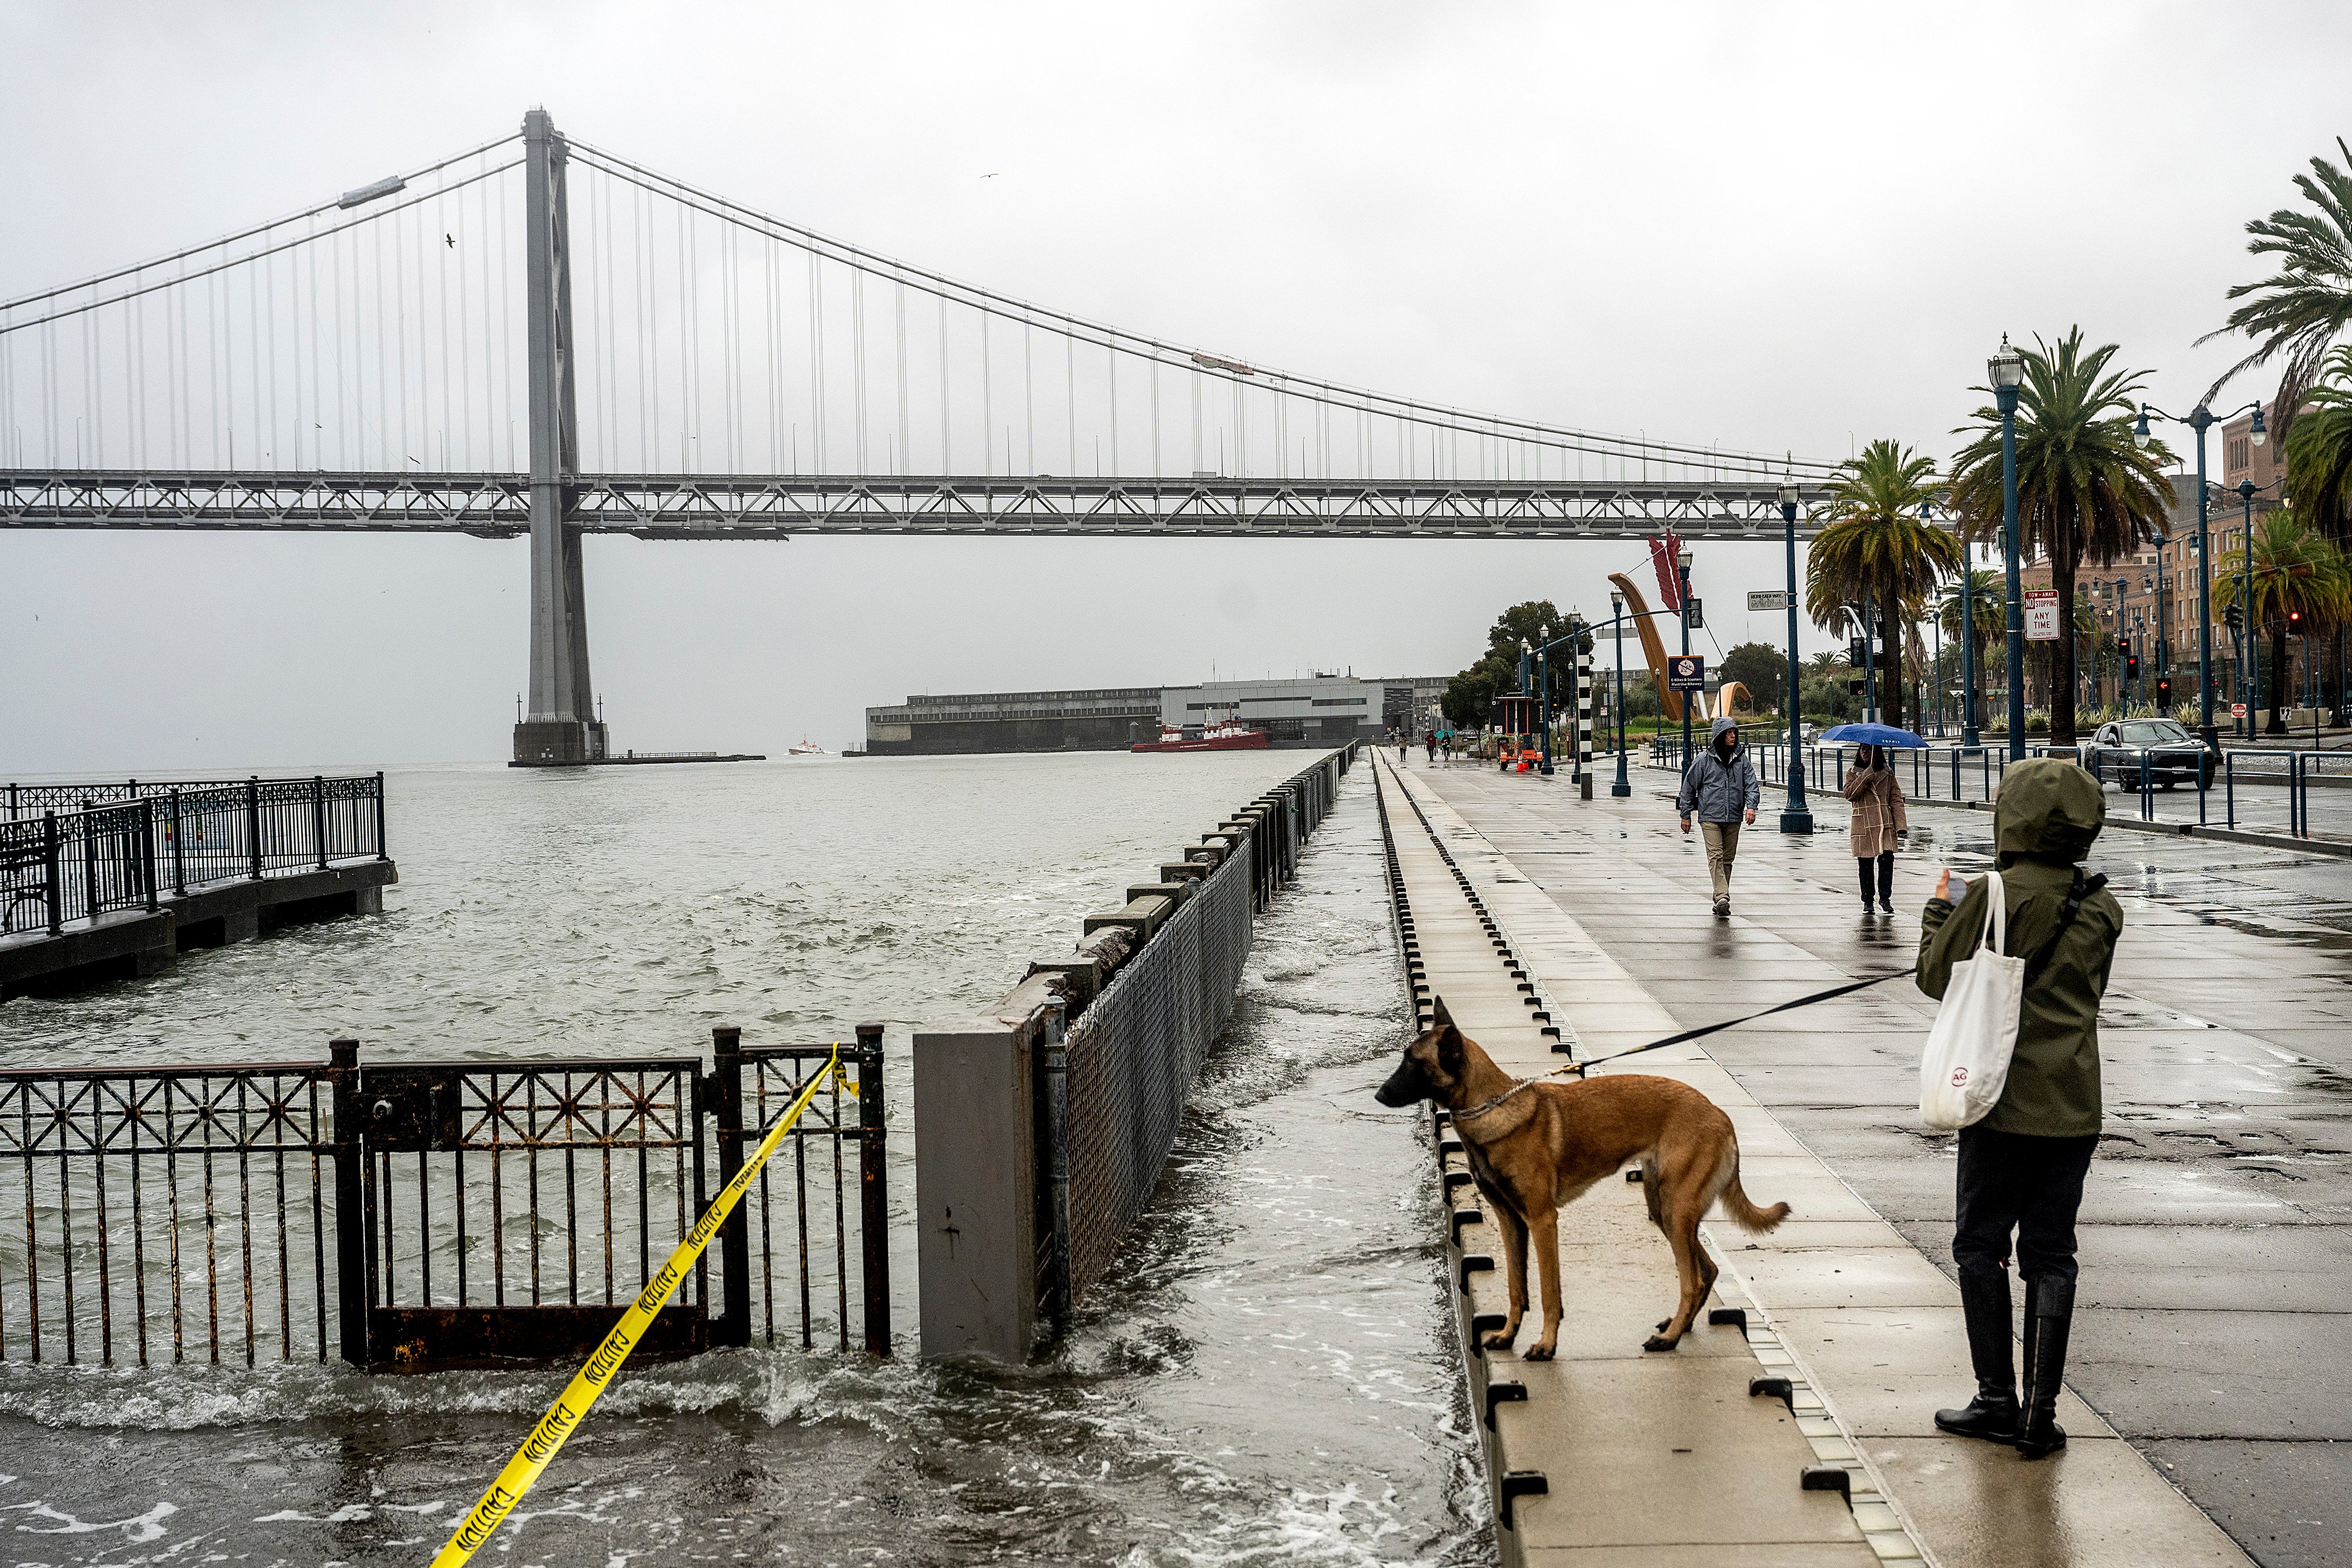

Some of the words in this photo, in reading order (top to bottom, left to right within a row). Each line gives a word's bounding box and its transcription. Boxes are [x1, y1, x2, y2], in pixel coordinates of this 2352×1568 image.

[2026, 599, 2034, 607] NO
[2034, 621, 2051, 629] TIME
[1953, 1072, 1967, 1081] AG
[639, 1262, 678, 1315] CAUTION
[584, 1328, 630, 1386] CAUTION
[524, 1402, 576, 1464] CAUTION
[456, 1486, 515, 1552] CAUTION
